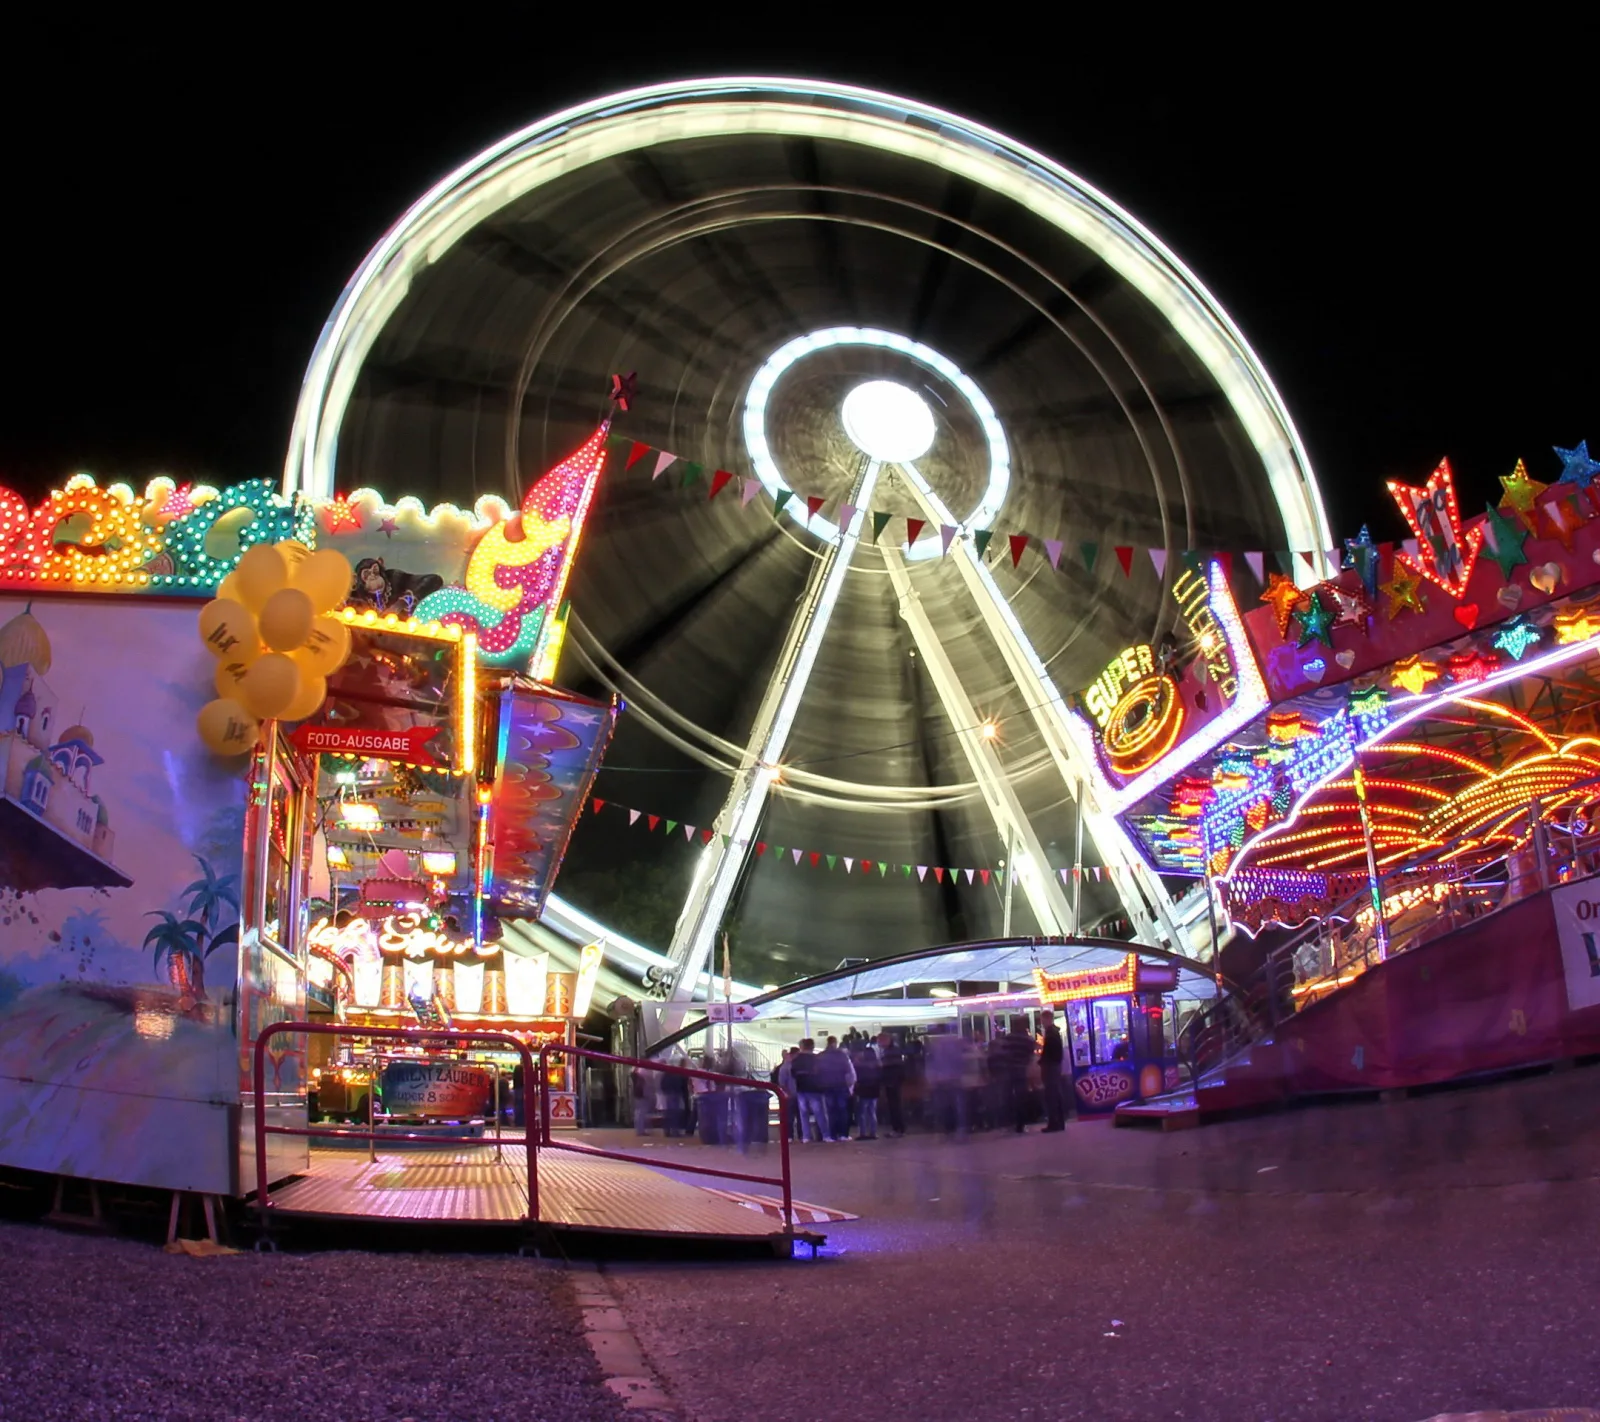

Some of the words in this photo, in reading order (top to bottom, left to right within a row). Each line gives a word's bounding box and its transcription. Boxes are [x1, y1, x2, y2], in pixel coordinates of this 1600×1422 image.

[1085, 644, 1154, 727] SUPER
[307, 732, 410, 751] FOTO-AUSGABE
[1047, 972, 1127, 992] Chip-Kasse
[435, 1068, 484, 1087] ZAUBER
[1078, 1074, 1128, 1095] Disco
[427, 1091, 437, 1103] 8
[1094, 1087, 1119, 1102] Star
